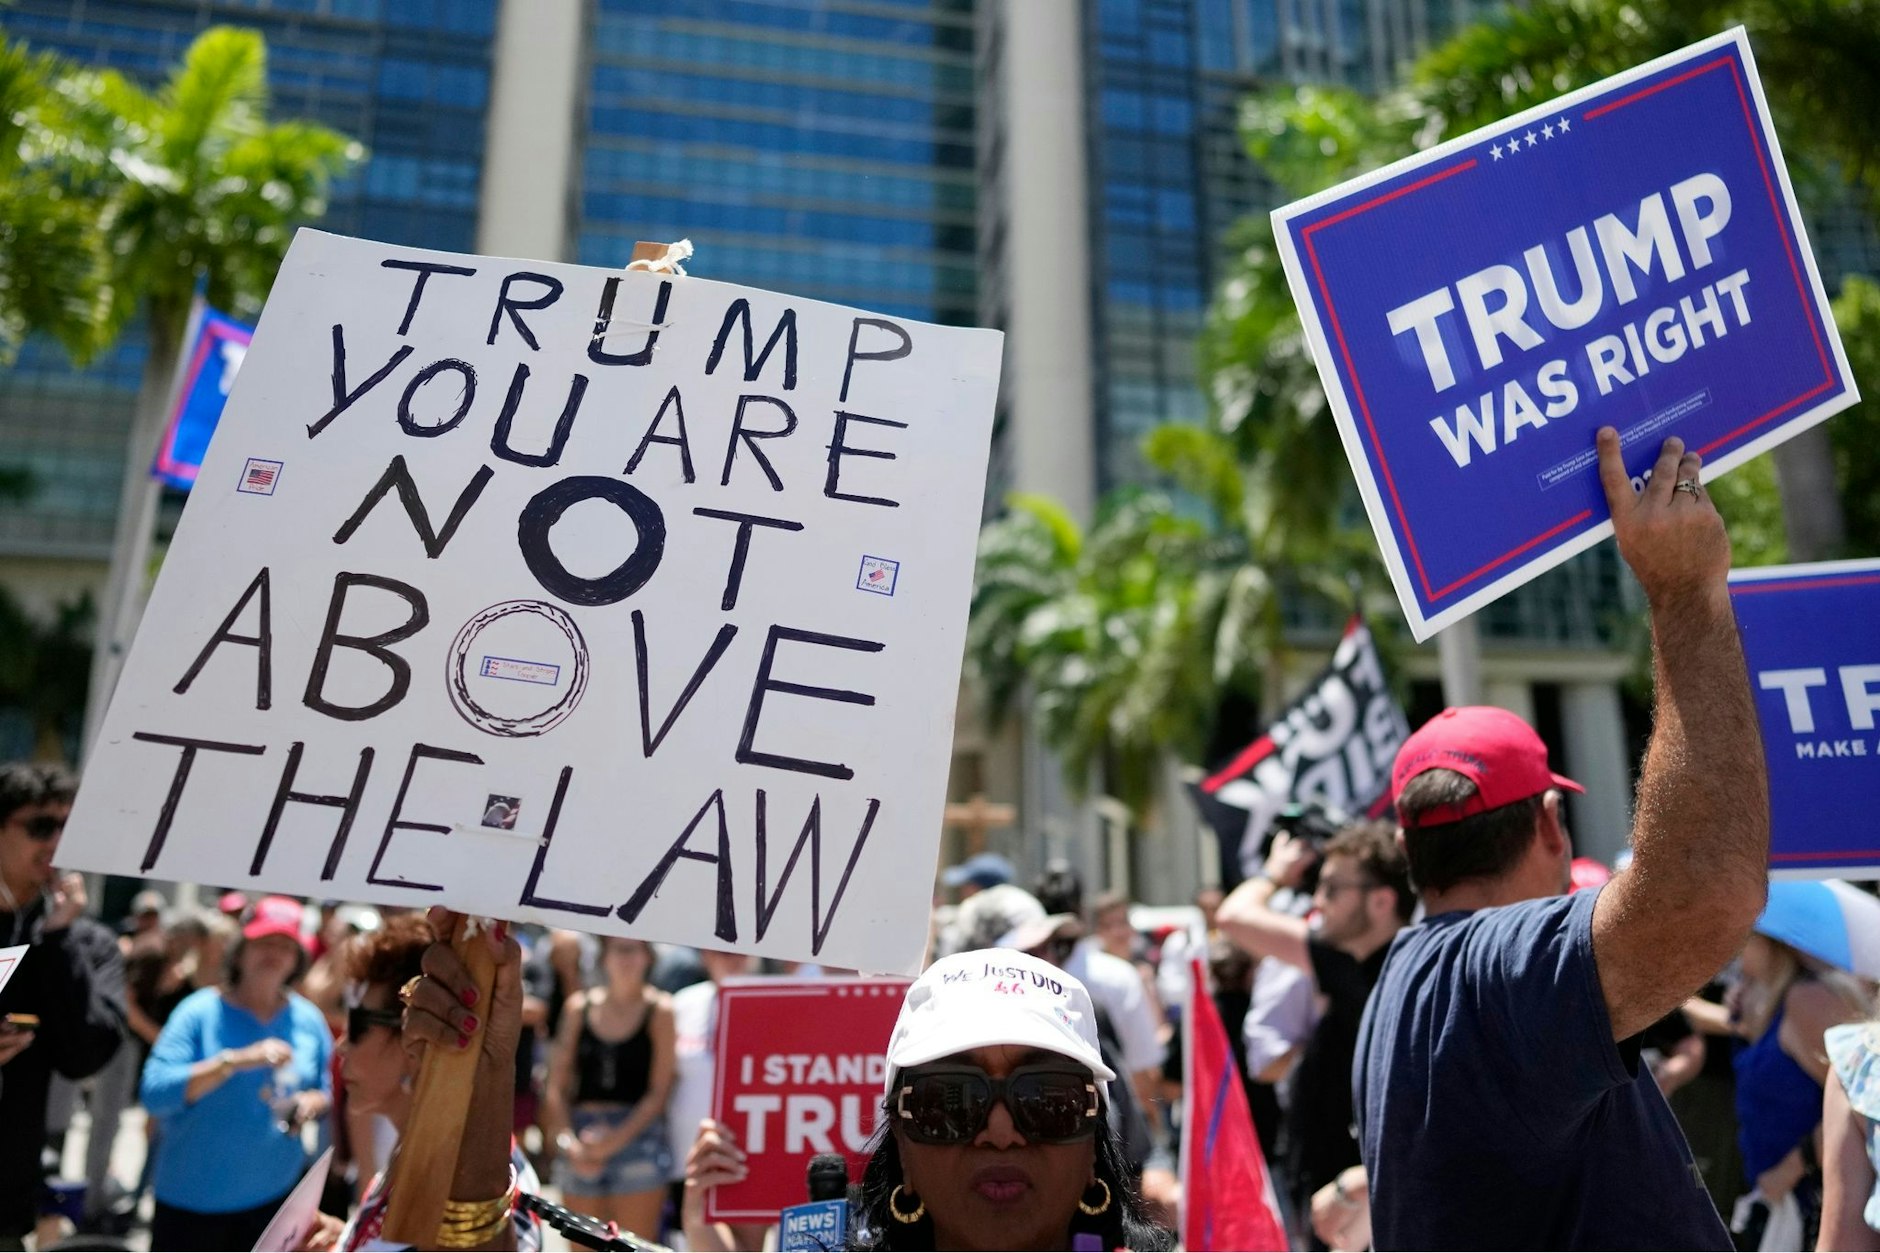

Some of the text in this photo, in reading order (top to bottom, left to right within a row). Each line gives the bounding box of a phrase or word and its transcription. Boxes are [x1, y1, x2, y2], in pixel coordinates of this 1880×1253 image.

[381, 259, 912, 403] TRUMP
[1386, 173, 1731, 393] TRUMP
[306, 324, 589, 468] YOU
[623, 385, 907, 508] ARE
[1430, 269, 1751, 467] WAS RIGHT
[333, 454, 804, 611] NOT
[173, 567, 885, 780] ABOVE
[1796, 740, 1867, 759] MAKE
[133, 732, 880, 956] THE LAW
[943, 969, 973, 984] WE
[981, 964, 1026, 980] JUST
[994, 981, 1024, 995] 46
[741, 1054, 886, 1085] I STAND
[788, 1212, 834, 1233] NEWS
